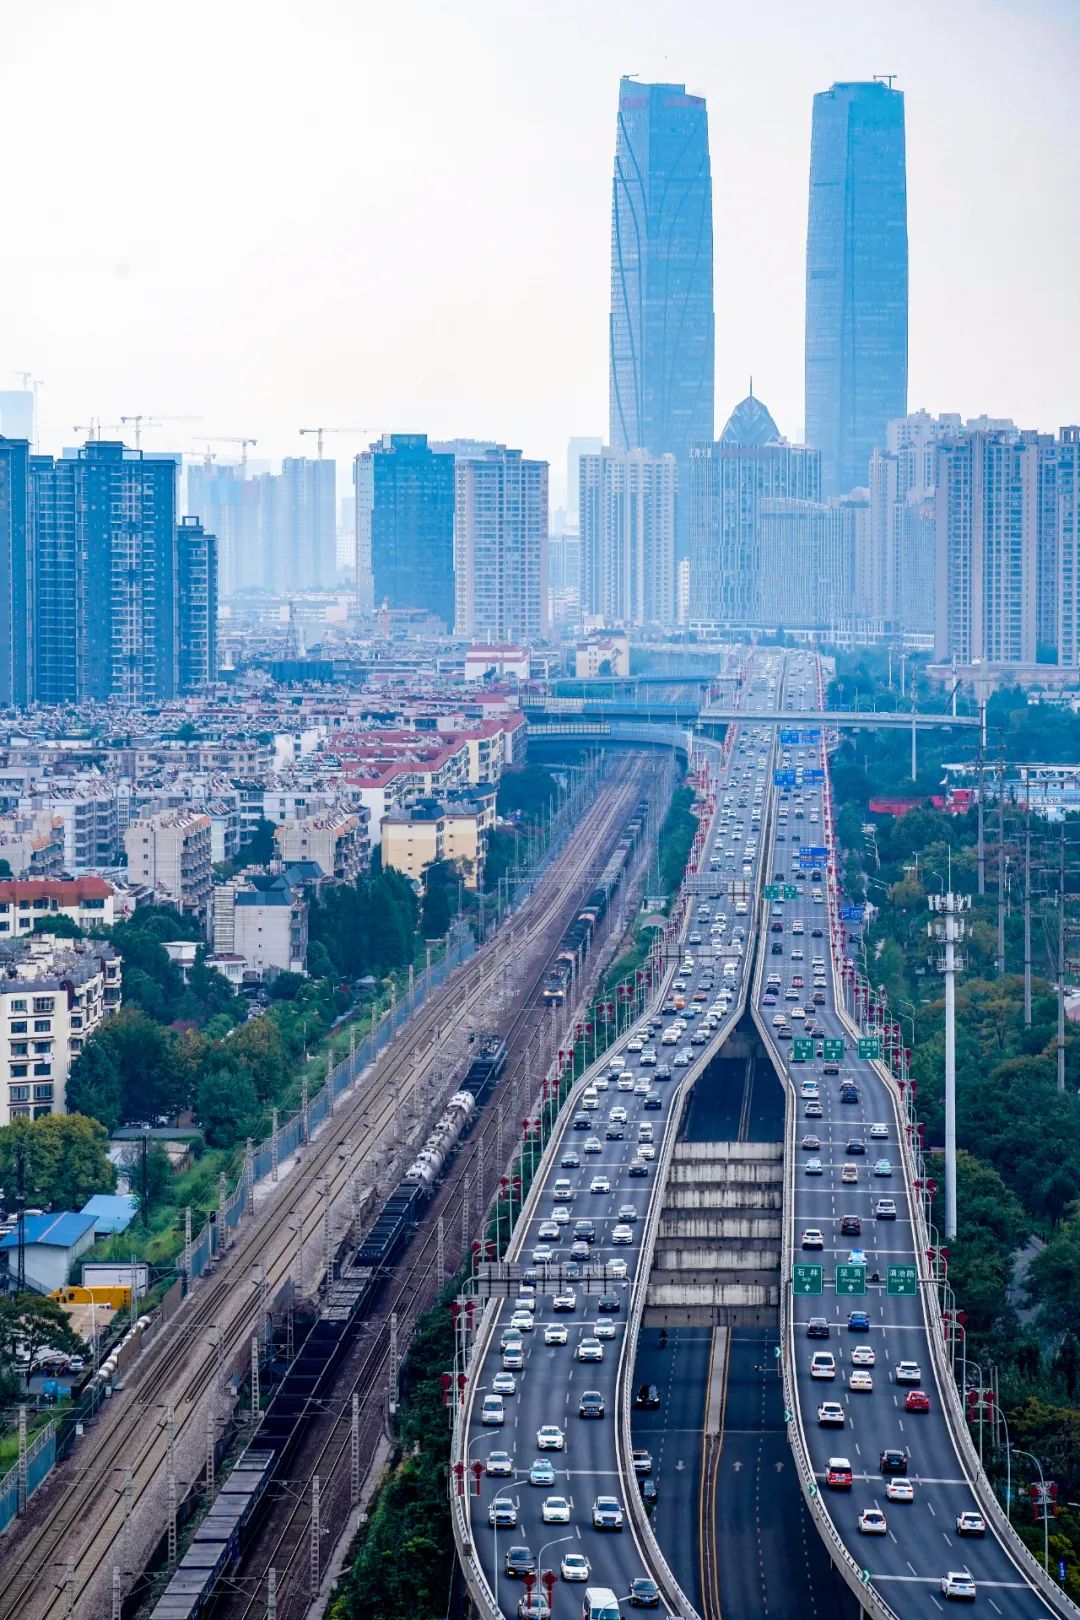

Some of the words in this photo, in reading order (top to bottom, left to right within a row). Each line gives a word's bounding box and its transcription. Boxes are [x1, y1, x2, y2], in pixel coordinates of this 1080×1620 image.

[797, 1268, 818, 1277] 石林
[840, 1268, 861, 1277] 呈贡
[889, 1269, 915, 1278] 滇池路
